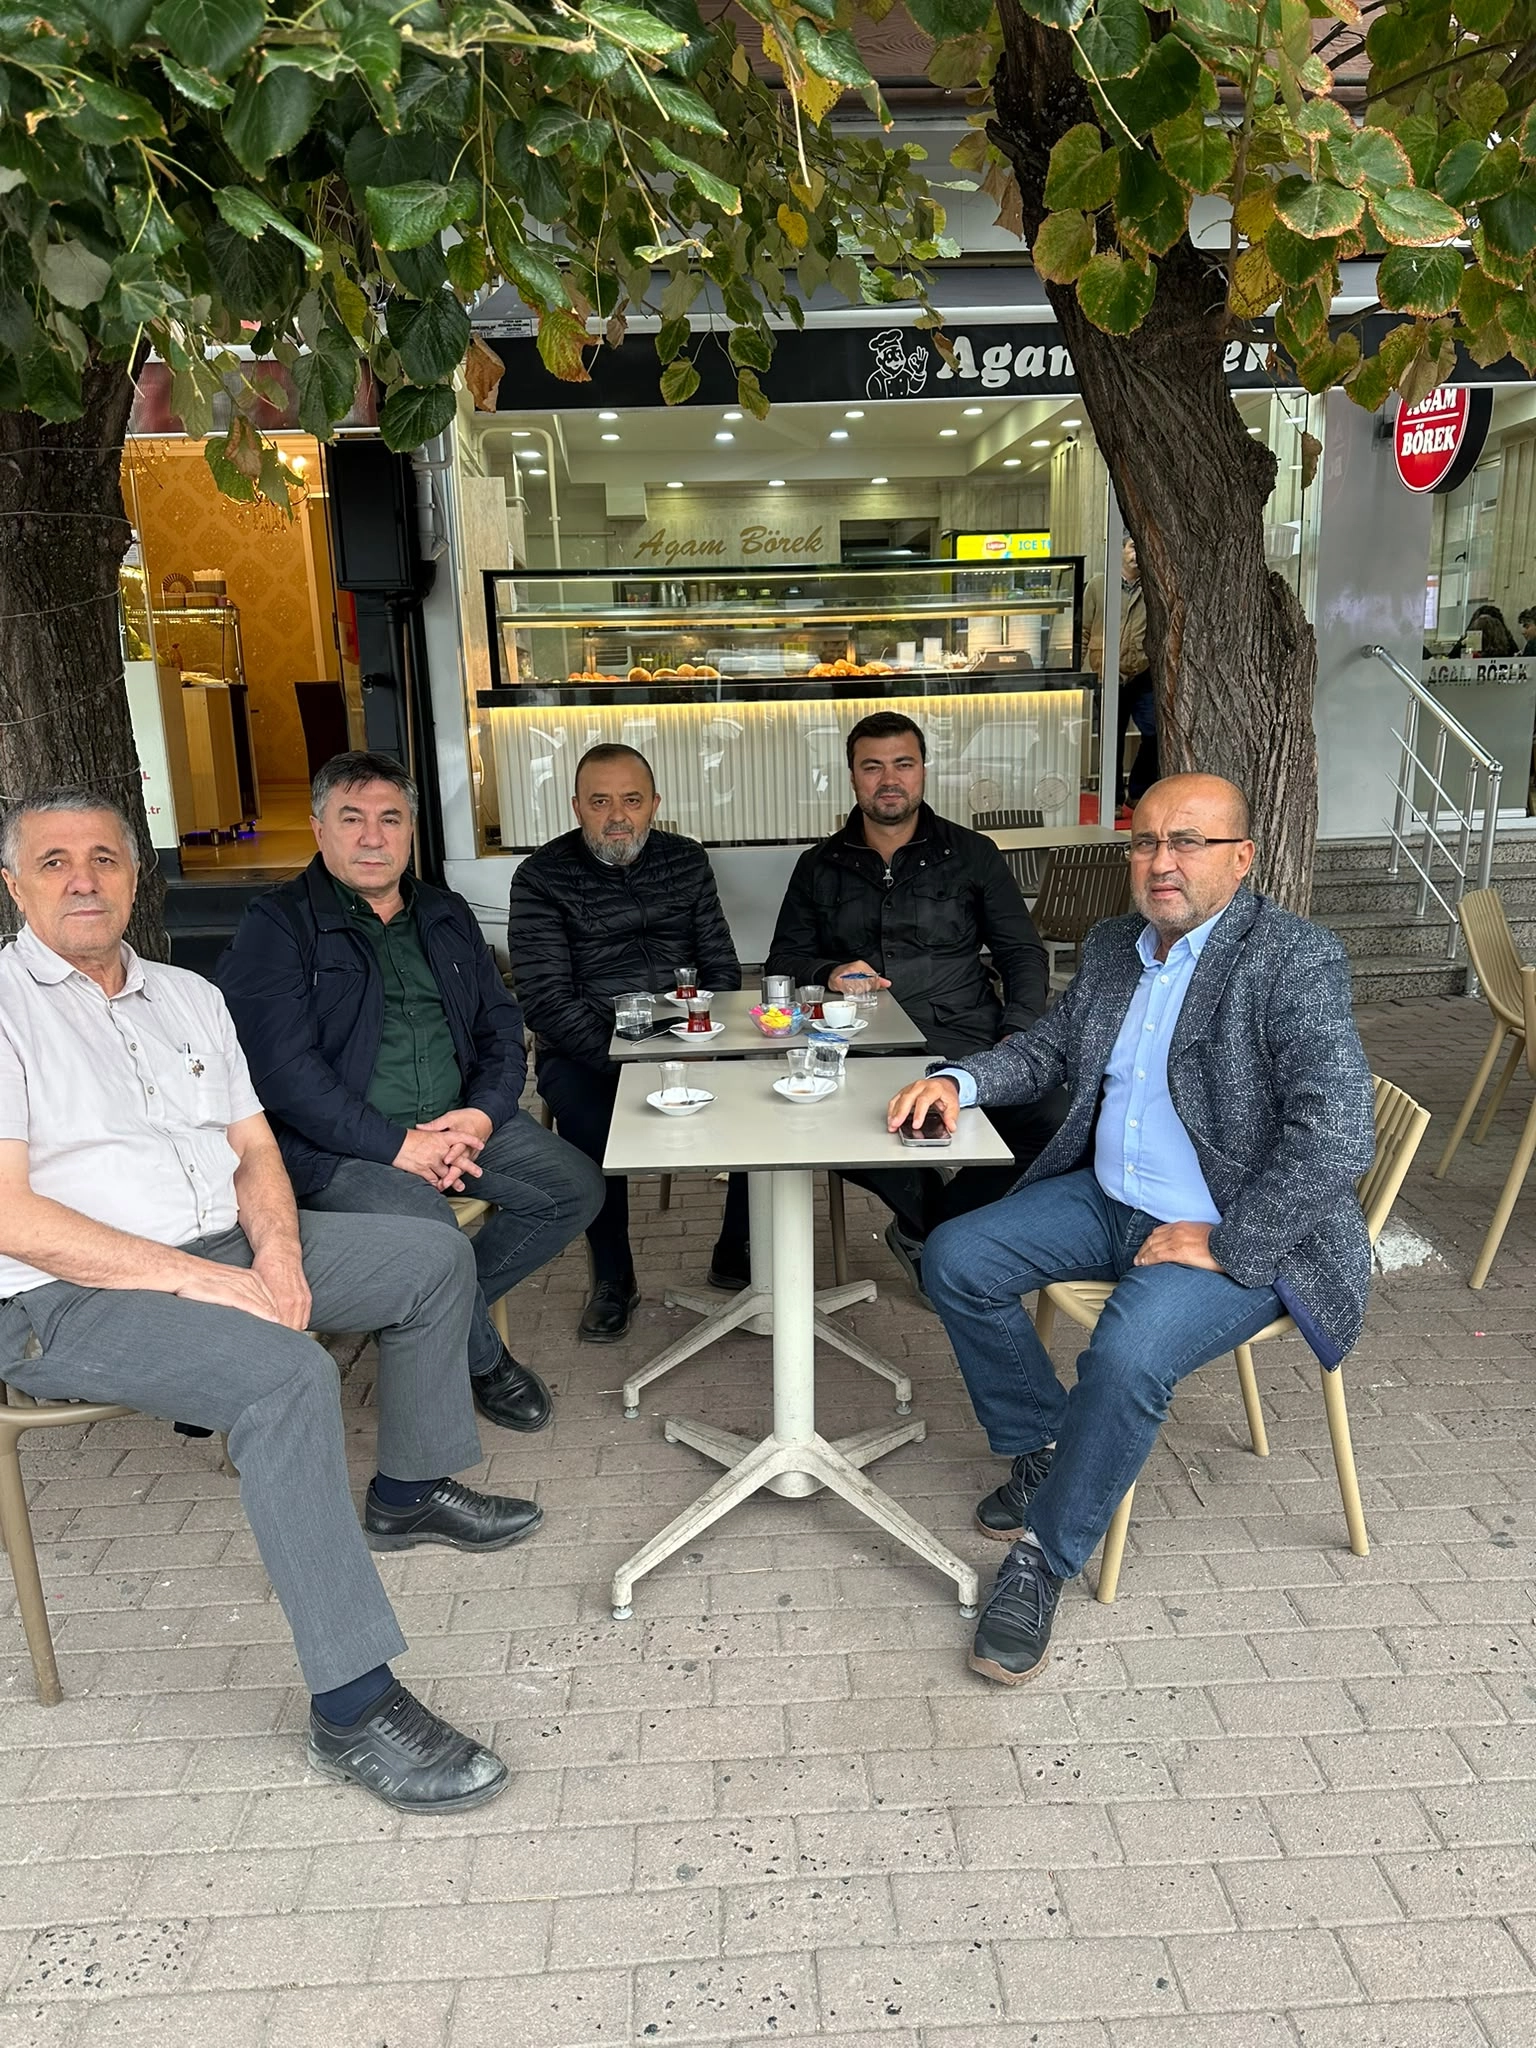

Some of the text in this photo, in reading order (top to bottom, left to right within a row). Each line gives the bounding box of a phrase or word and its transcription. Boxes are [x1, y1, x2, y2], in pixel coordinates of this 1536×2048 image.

[1401, 422, 1457, 457] BÖREK
[633, 525, 824, 566] Agam Börek
[1019, 540, 1038, 550] ICE
[1477, 659, 1529, 685] BÖREK
